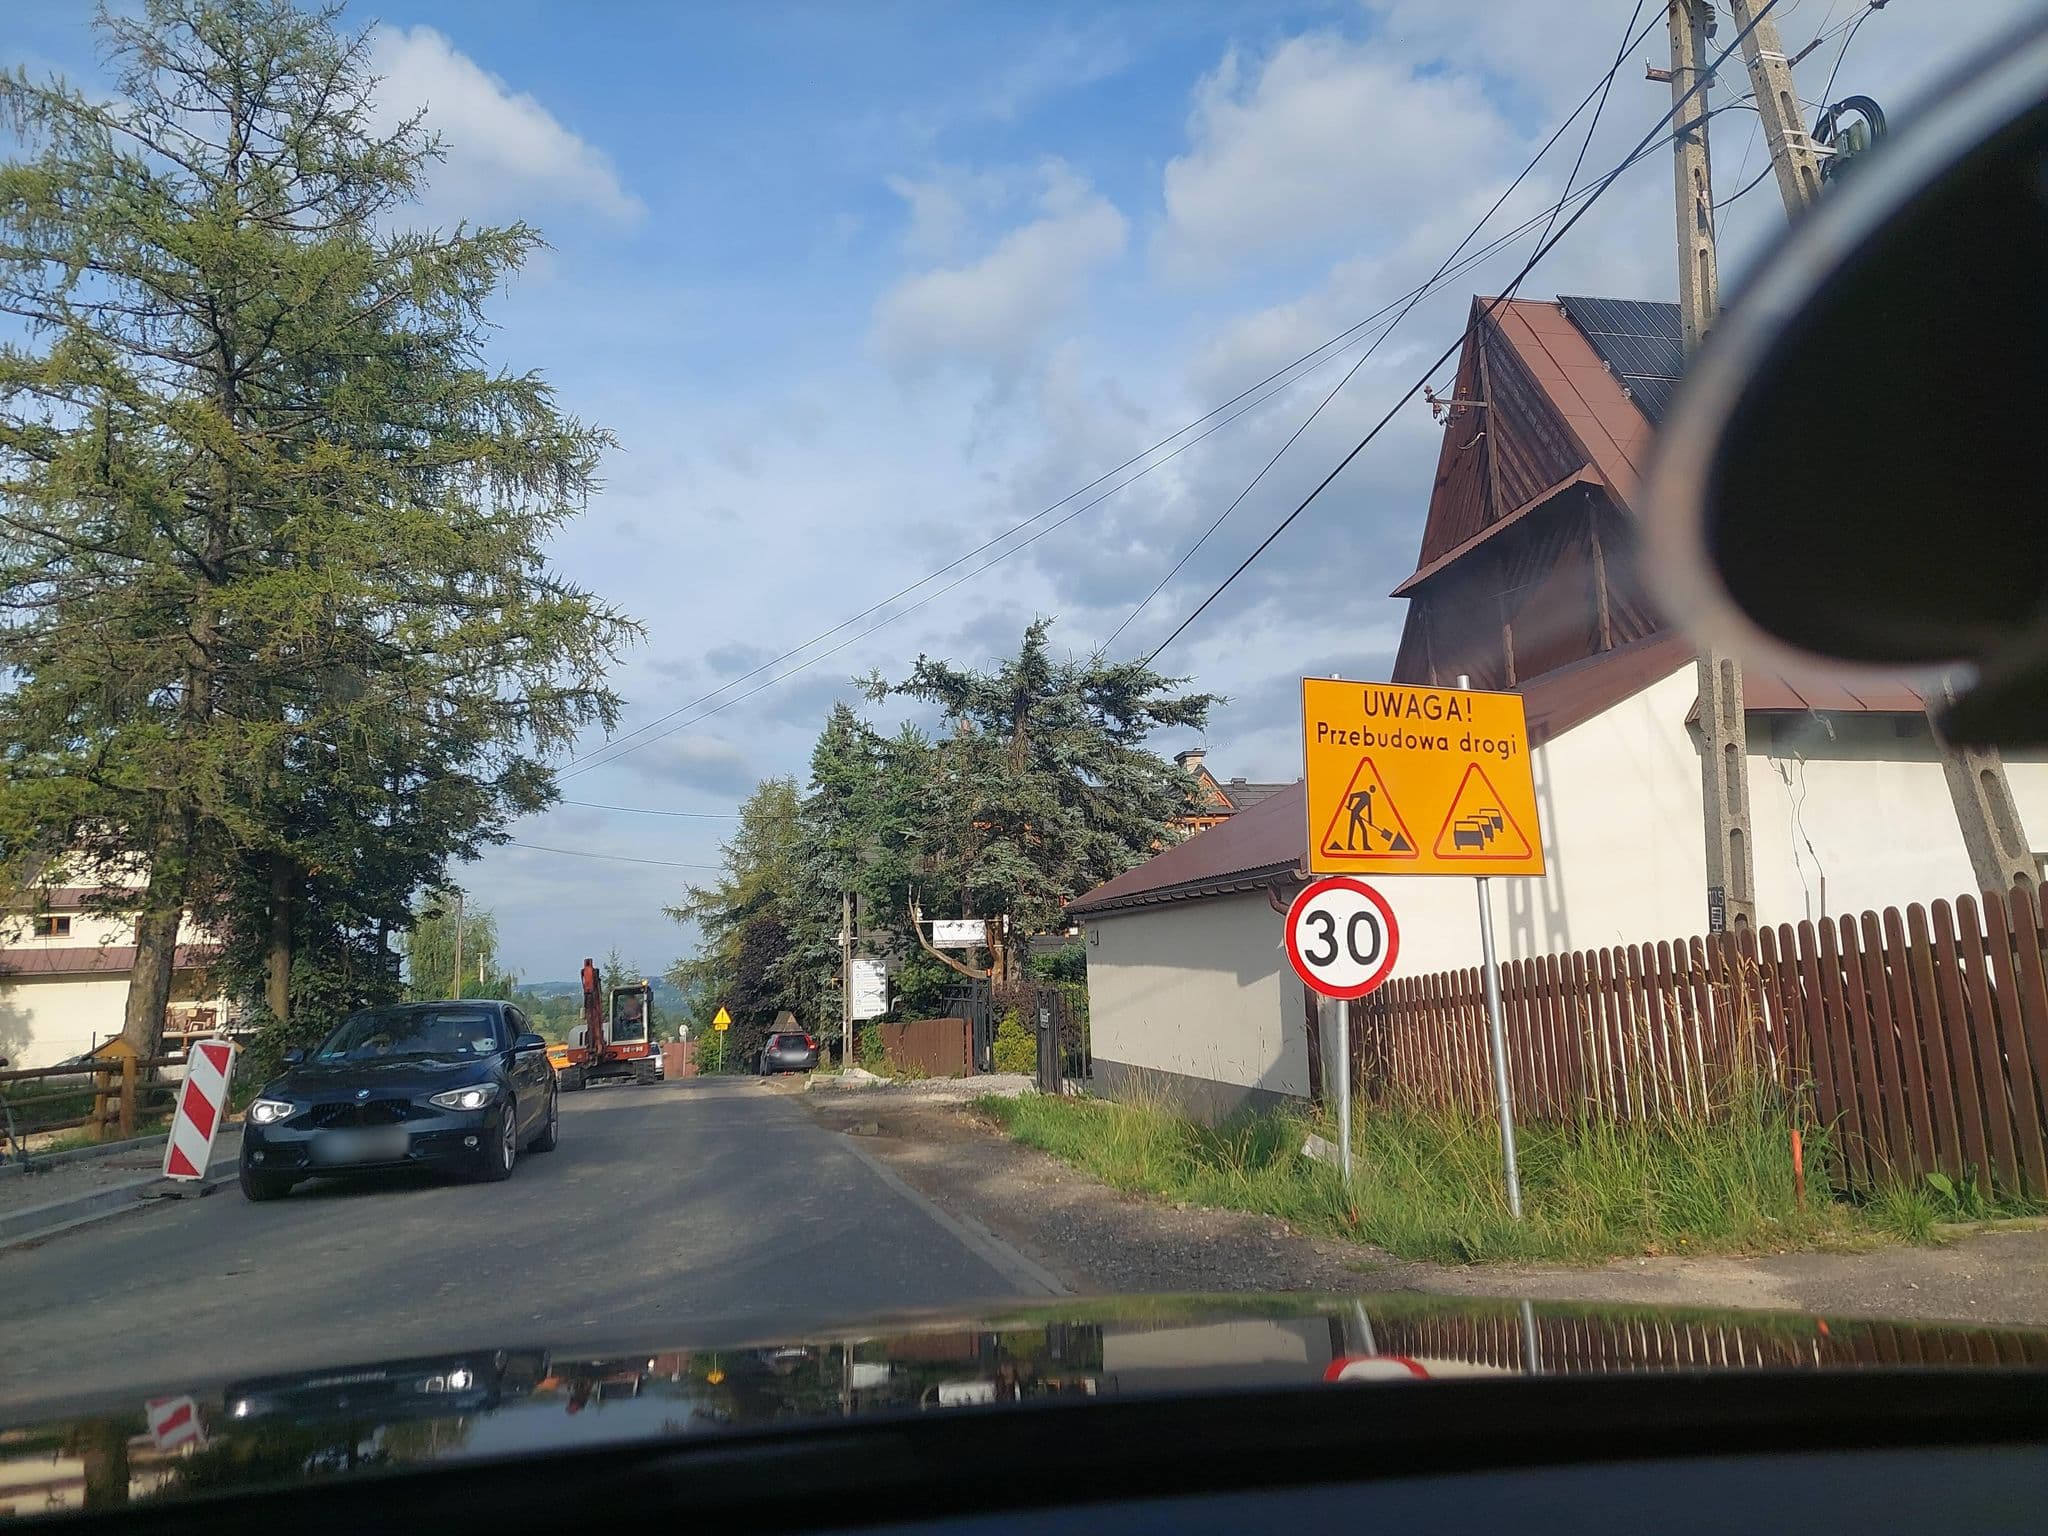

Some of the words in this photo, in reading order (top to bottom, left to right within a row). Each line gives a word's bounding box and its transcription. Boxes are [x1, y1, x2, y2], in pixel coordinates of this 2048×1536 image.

[1363, 690, 1473, 723] UWAGA!
[1317, 721, 1450, 751] Przebudowa
[1459, 733, 1518, 760] drogi
[1304, 909, 1382, 967] 30
